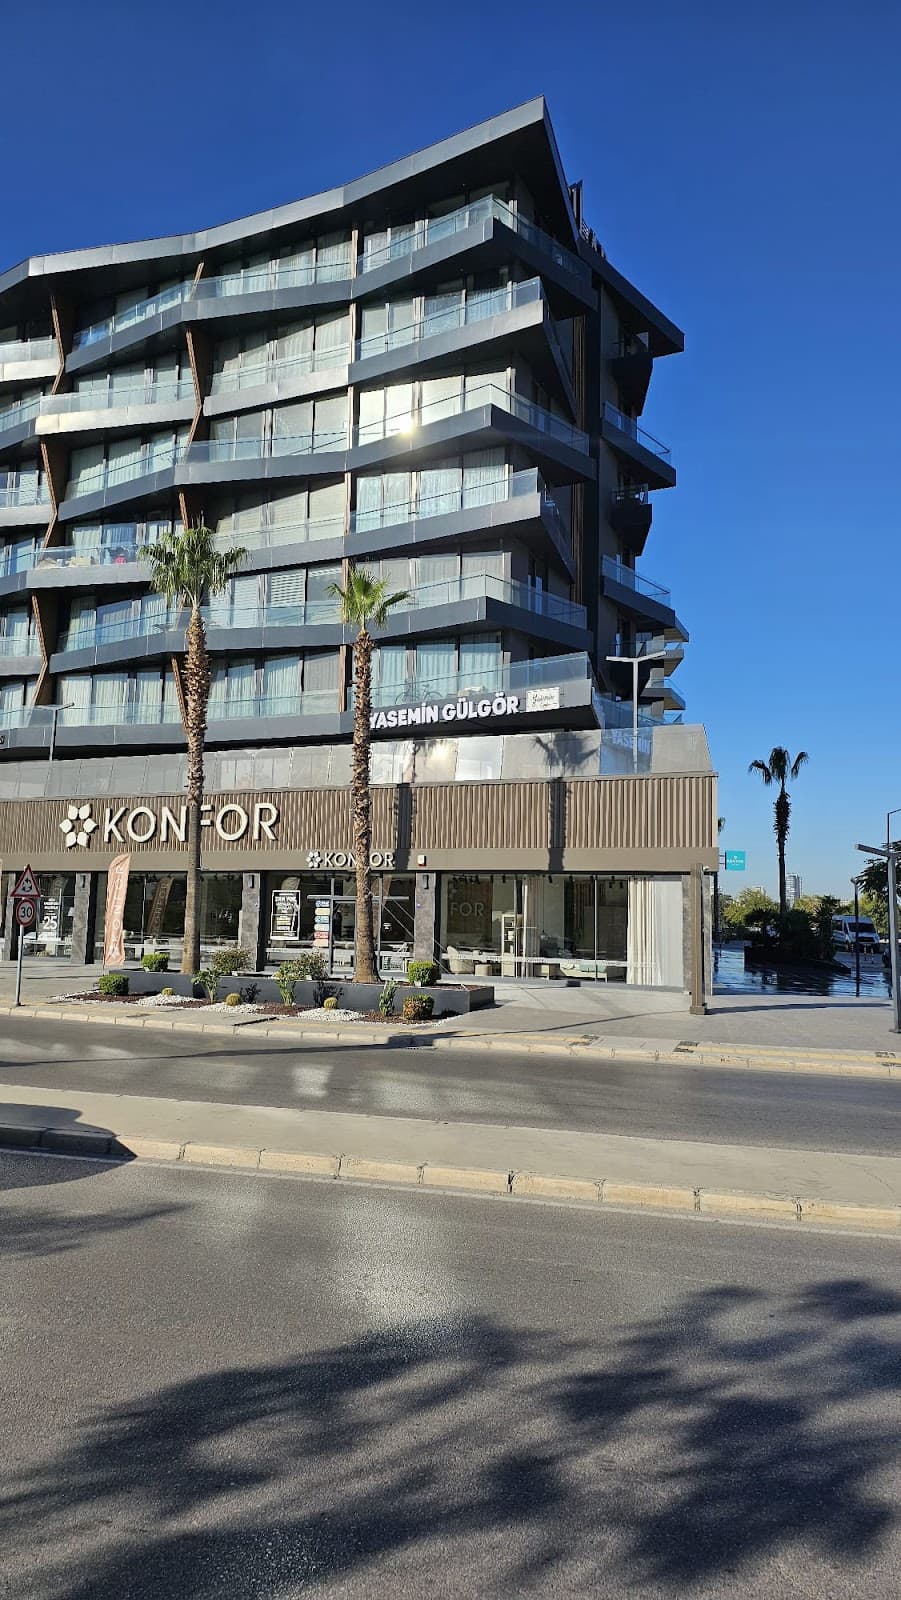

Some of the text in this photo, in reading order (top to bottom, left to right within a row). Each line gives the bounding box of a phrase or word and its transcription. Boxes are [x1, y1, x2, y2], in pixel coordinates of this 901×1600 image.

[369, 703, 438, 728] YASEMİN
[442, 692, 519, 721] GÜLGÖR
[324, 852, 394, 867] KONOR
[20, 906, 32, 918] 30
[450, 902, 485, 917] FOR
